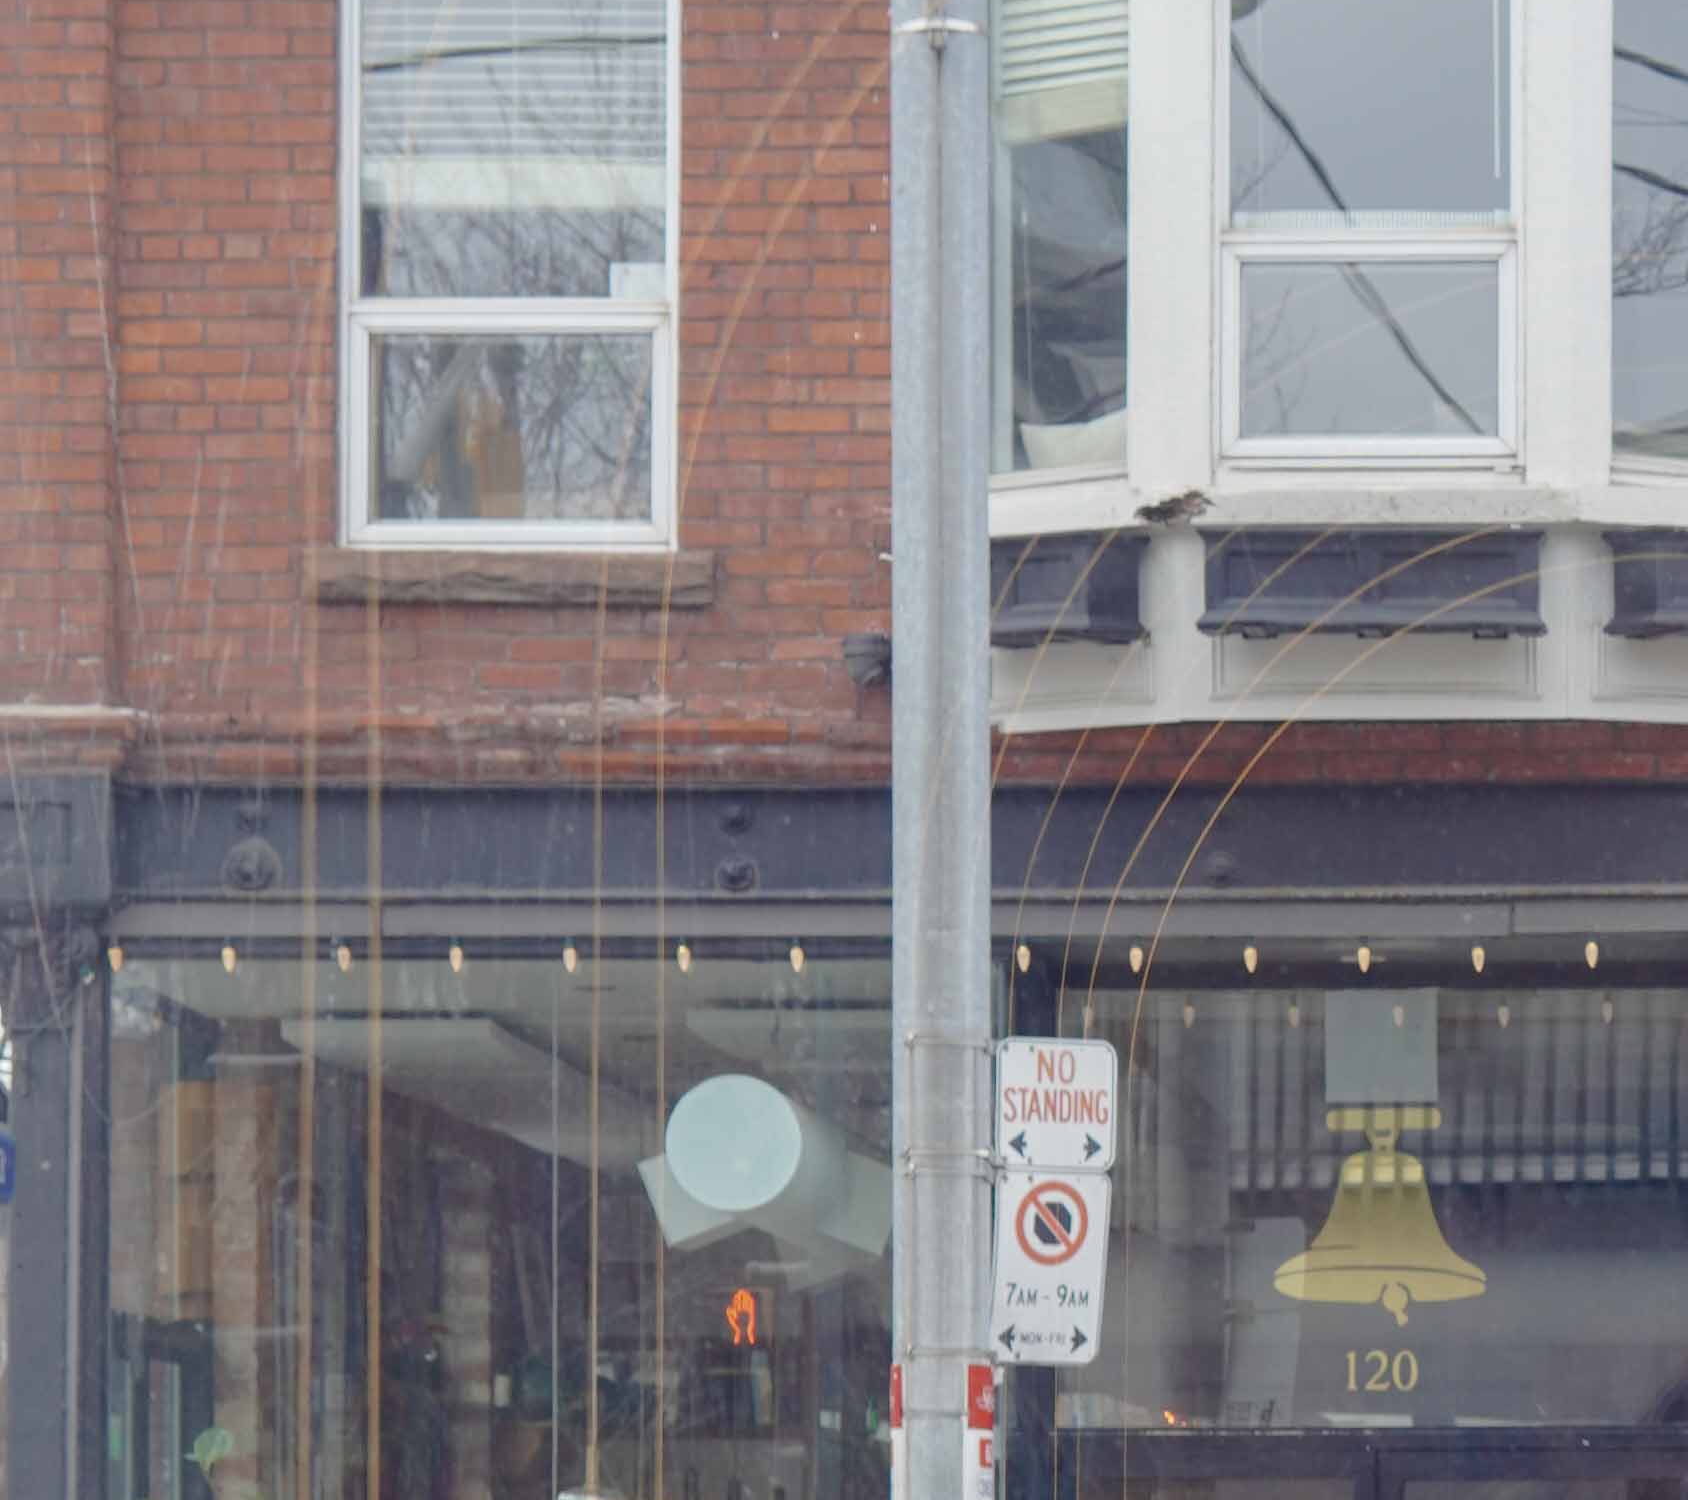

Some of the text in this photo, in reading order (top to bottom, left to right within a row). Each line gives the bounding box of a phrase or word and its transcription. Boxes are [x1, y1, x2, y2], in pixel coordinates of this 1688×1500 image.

[1037, 1049, 1076, 1084] NO
[1004, 1087, 1109, 1125] STANDING
[1006, 1283, 1038, 1307] 7AM
[1057, 1285, 1089, 1307] 9AM
[1020, 1331, 1067, 1346] MON-FRI
[1344, 1349, 1418, 1392] 120
